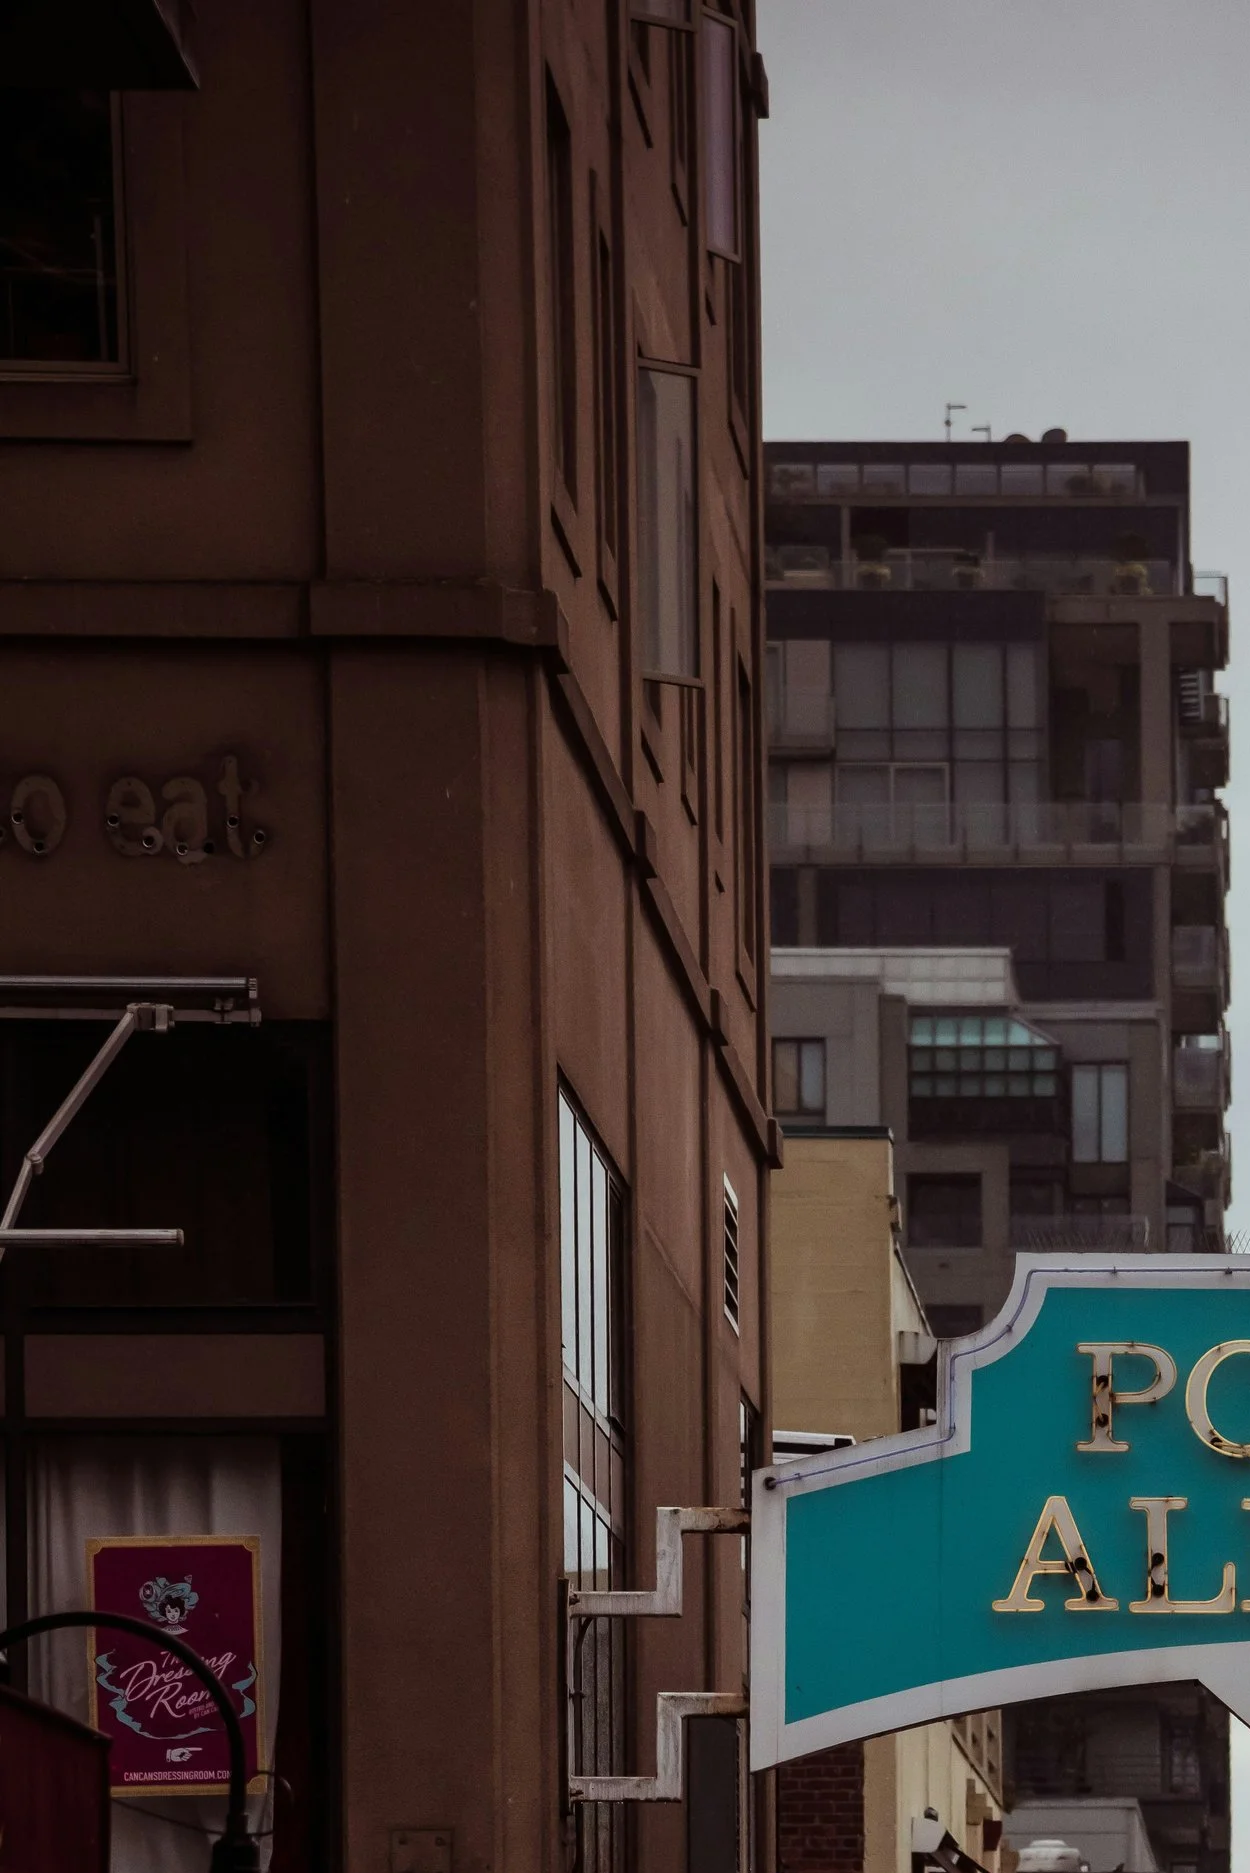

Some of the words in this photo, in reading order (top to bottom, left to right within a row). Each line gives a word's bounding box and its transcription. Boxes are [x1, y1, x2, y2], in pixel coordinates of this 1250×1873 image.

[105, 755, 265, 864] eat
[120, 1652, 237, 1702] Dressng
[160, 1650, 181, 1668] Th
